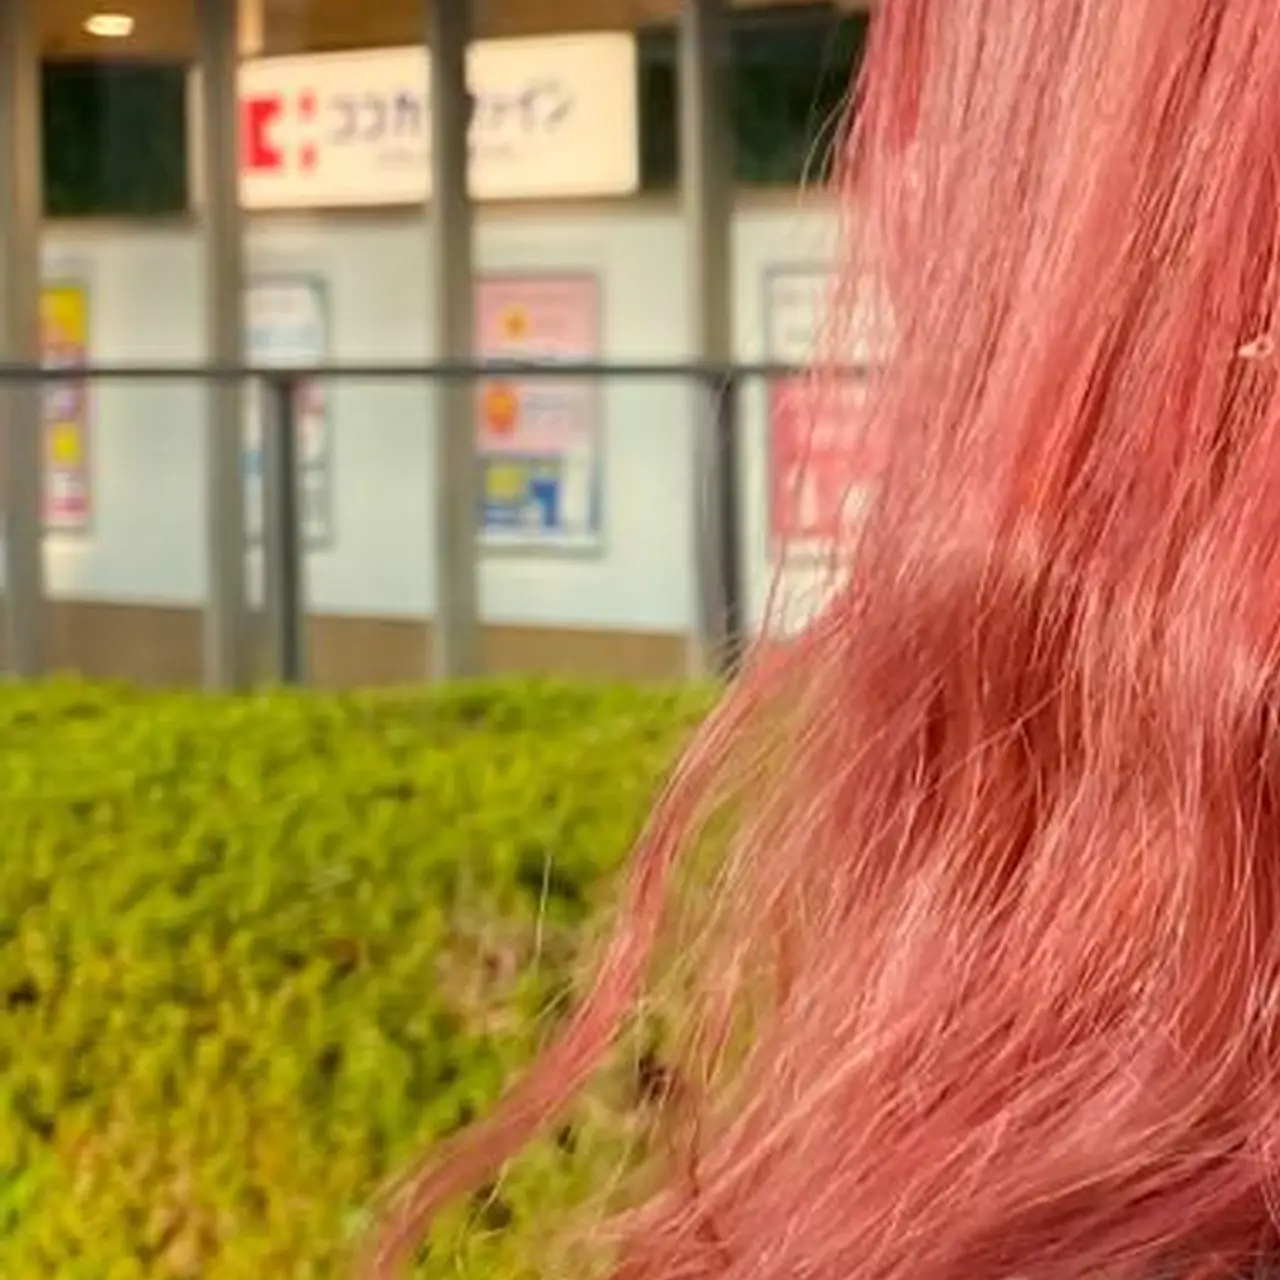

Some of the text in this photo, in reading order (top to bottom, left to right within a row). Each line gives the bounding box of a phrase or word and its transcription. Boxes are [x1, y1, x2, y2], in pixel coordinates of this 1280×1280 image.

[327, 79, 574, 144] ココカァイン
